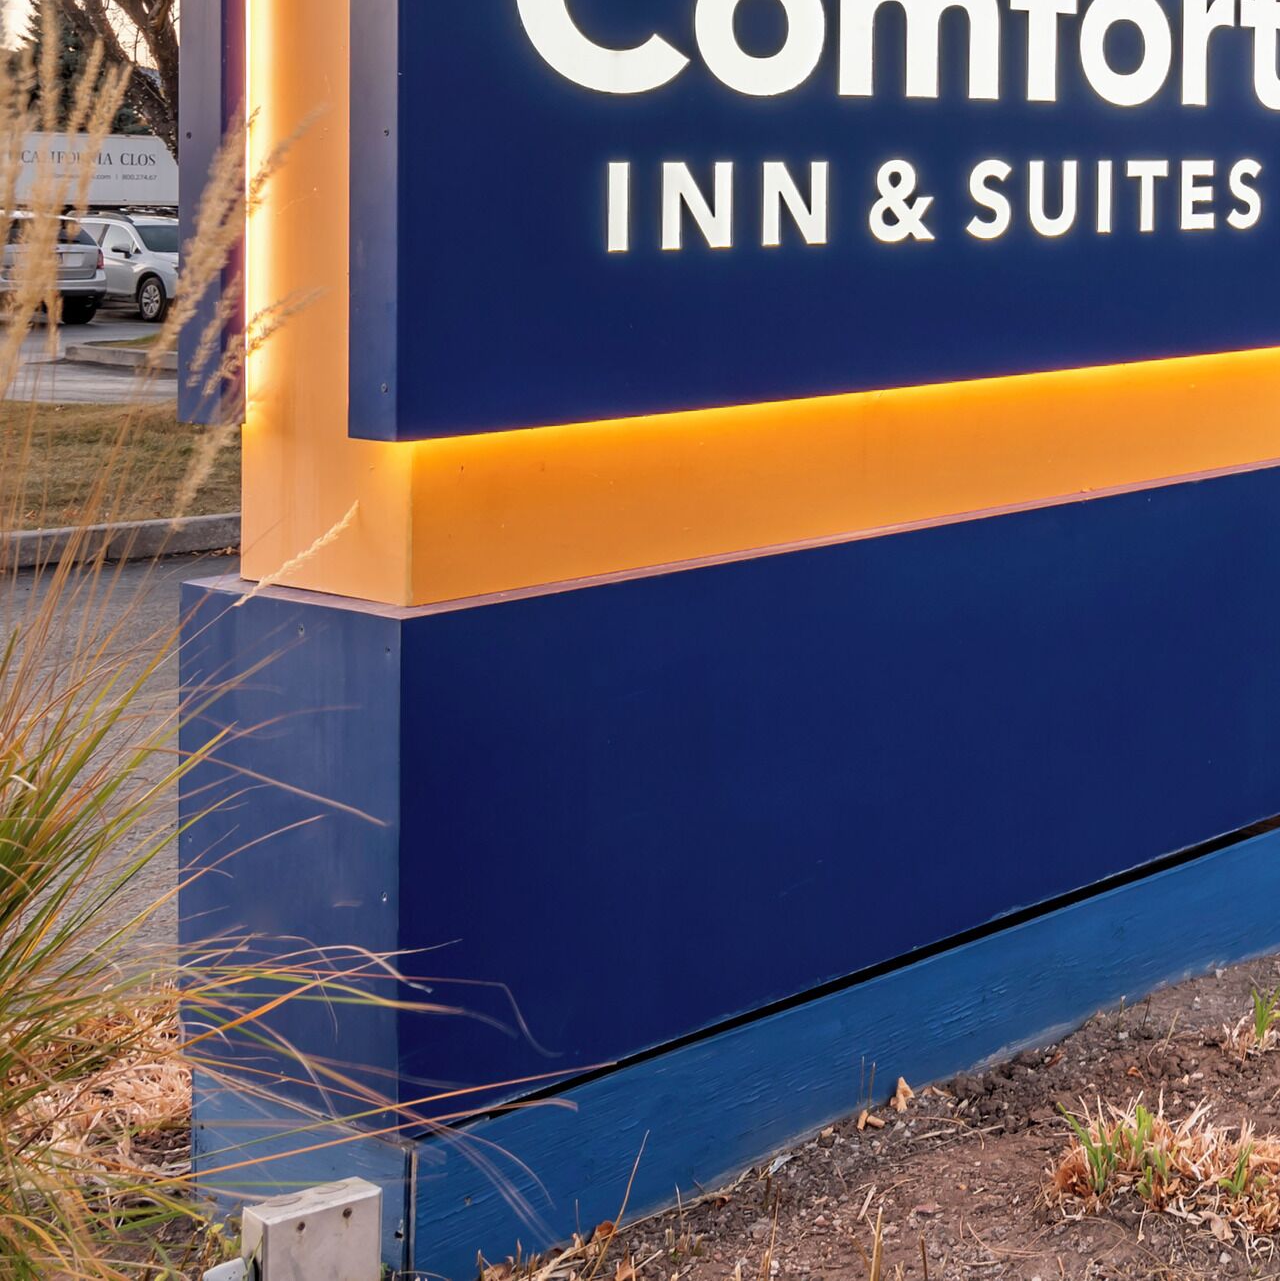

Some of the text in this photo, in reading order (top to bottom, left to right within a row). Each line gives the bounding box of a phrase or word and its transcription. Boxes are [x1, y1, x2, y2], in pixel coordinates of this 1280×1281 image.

[120, 152, 156, 166] CLOS
[607, 158, 1262, 252] INN & SUITES
